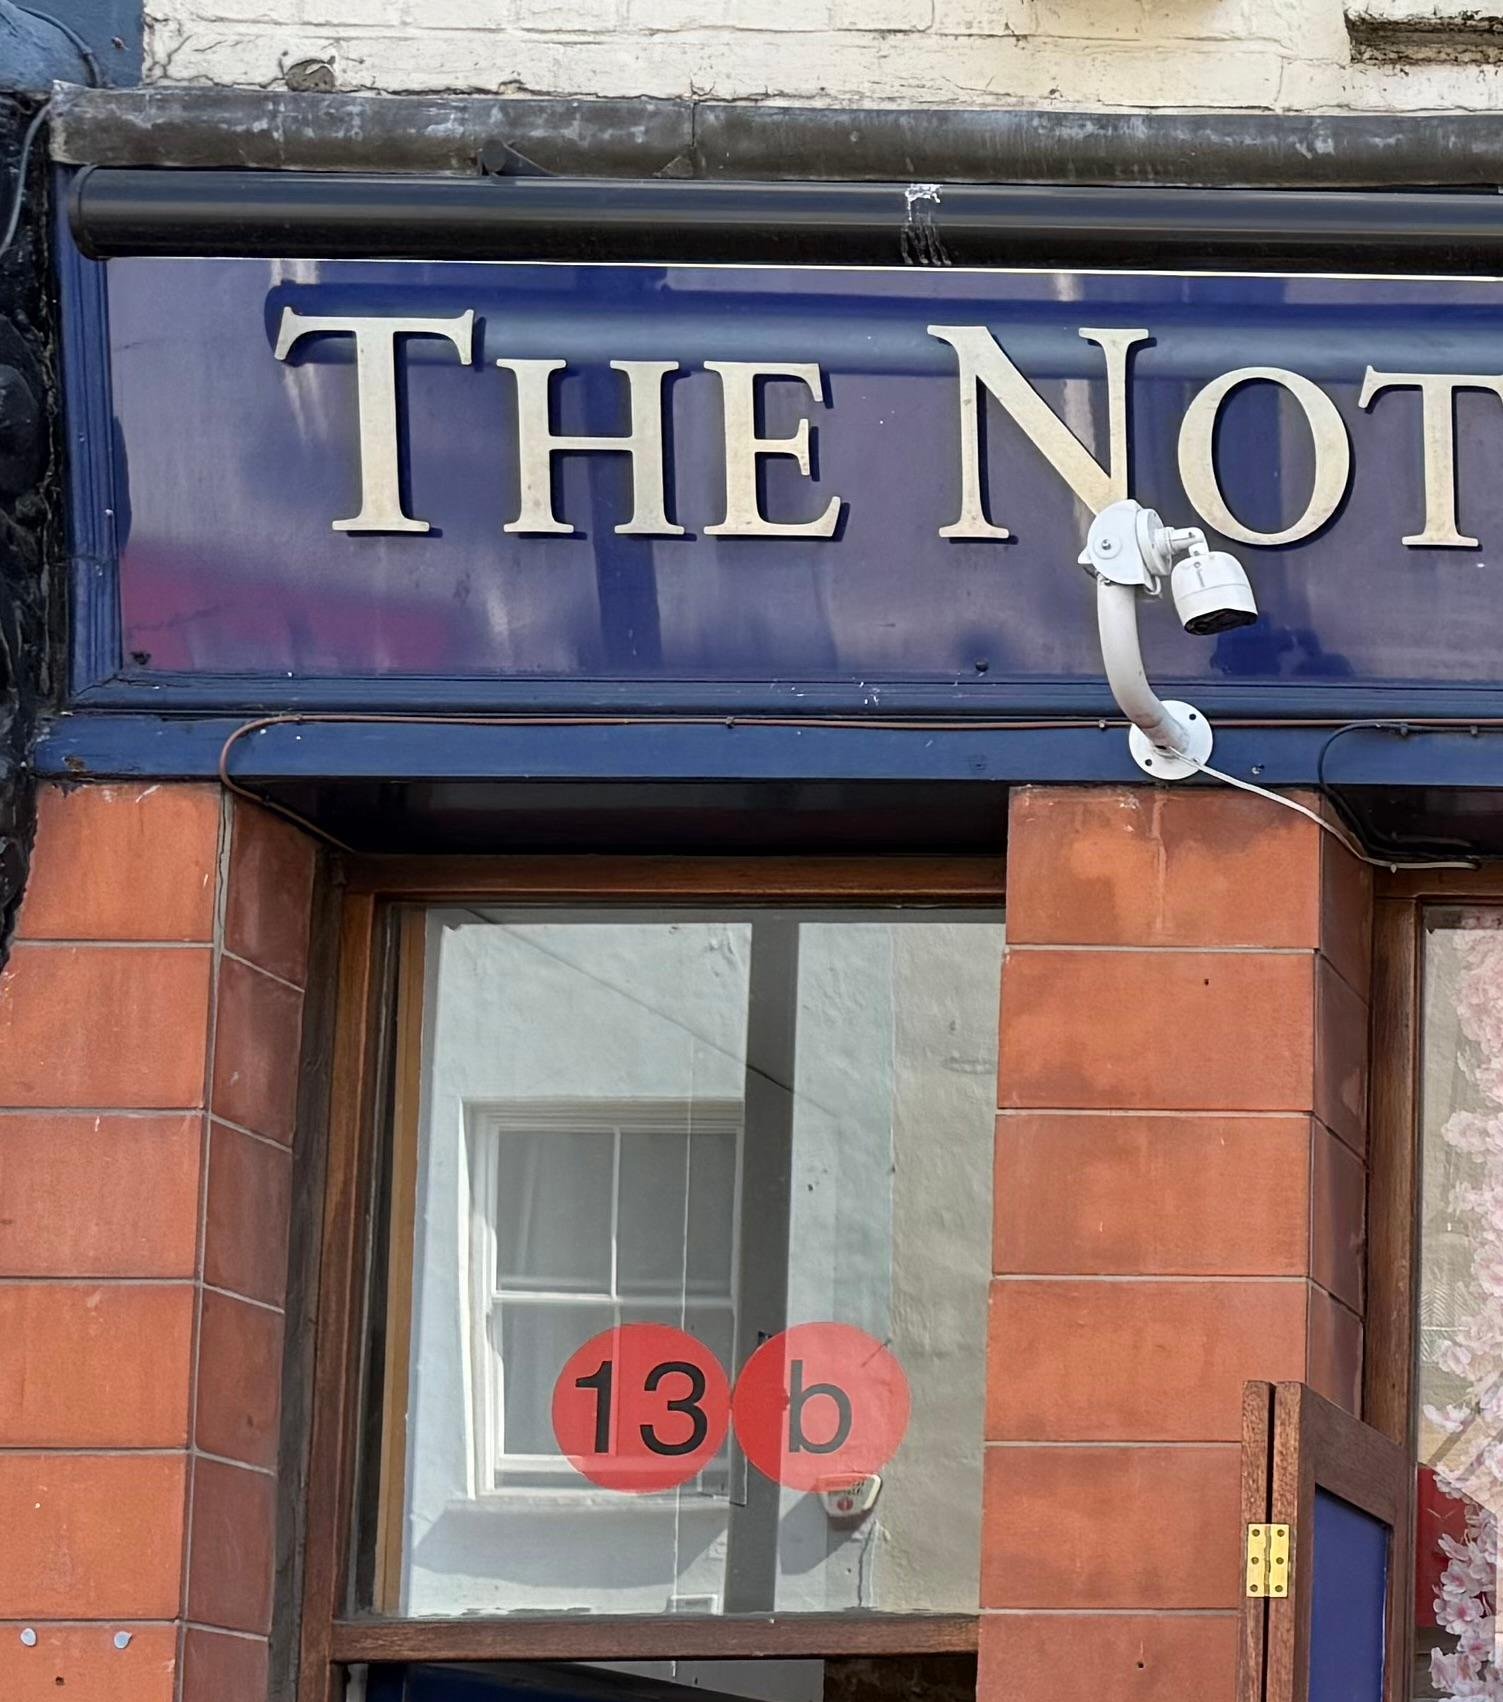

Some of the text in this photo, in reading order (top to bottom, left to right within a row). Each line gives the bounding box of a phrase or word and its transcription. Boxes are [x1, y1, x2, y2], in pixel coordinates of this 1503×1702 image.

[274, 307, 842, 538] THE
[575, 1359, 853, 1456] 13 b
